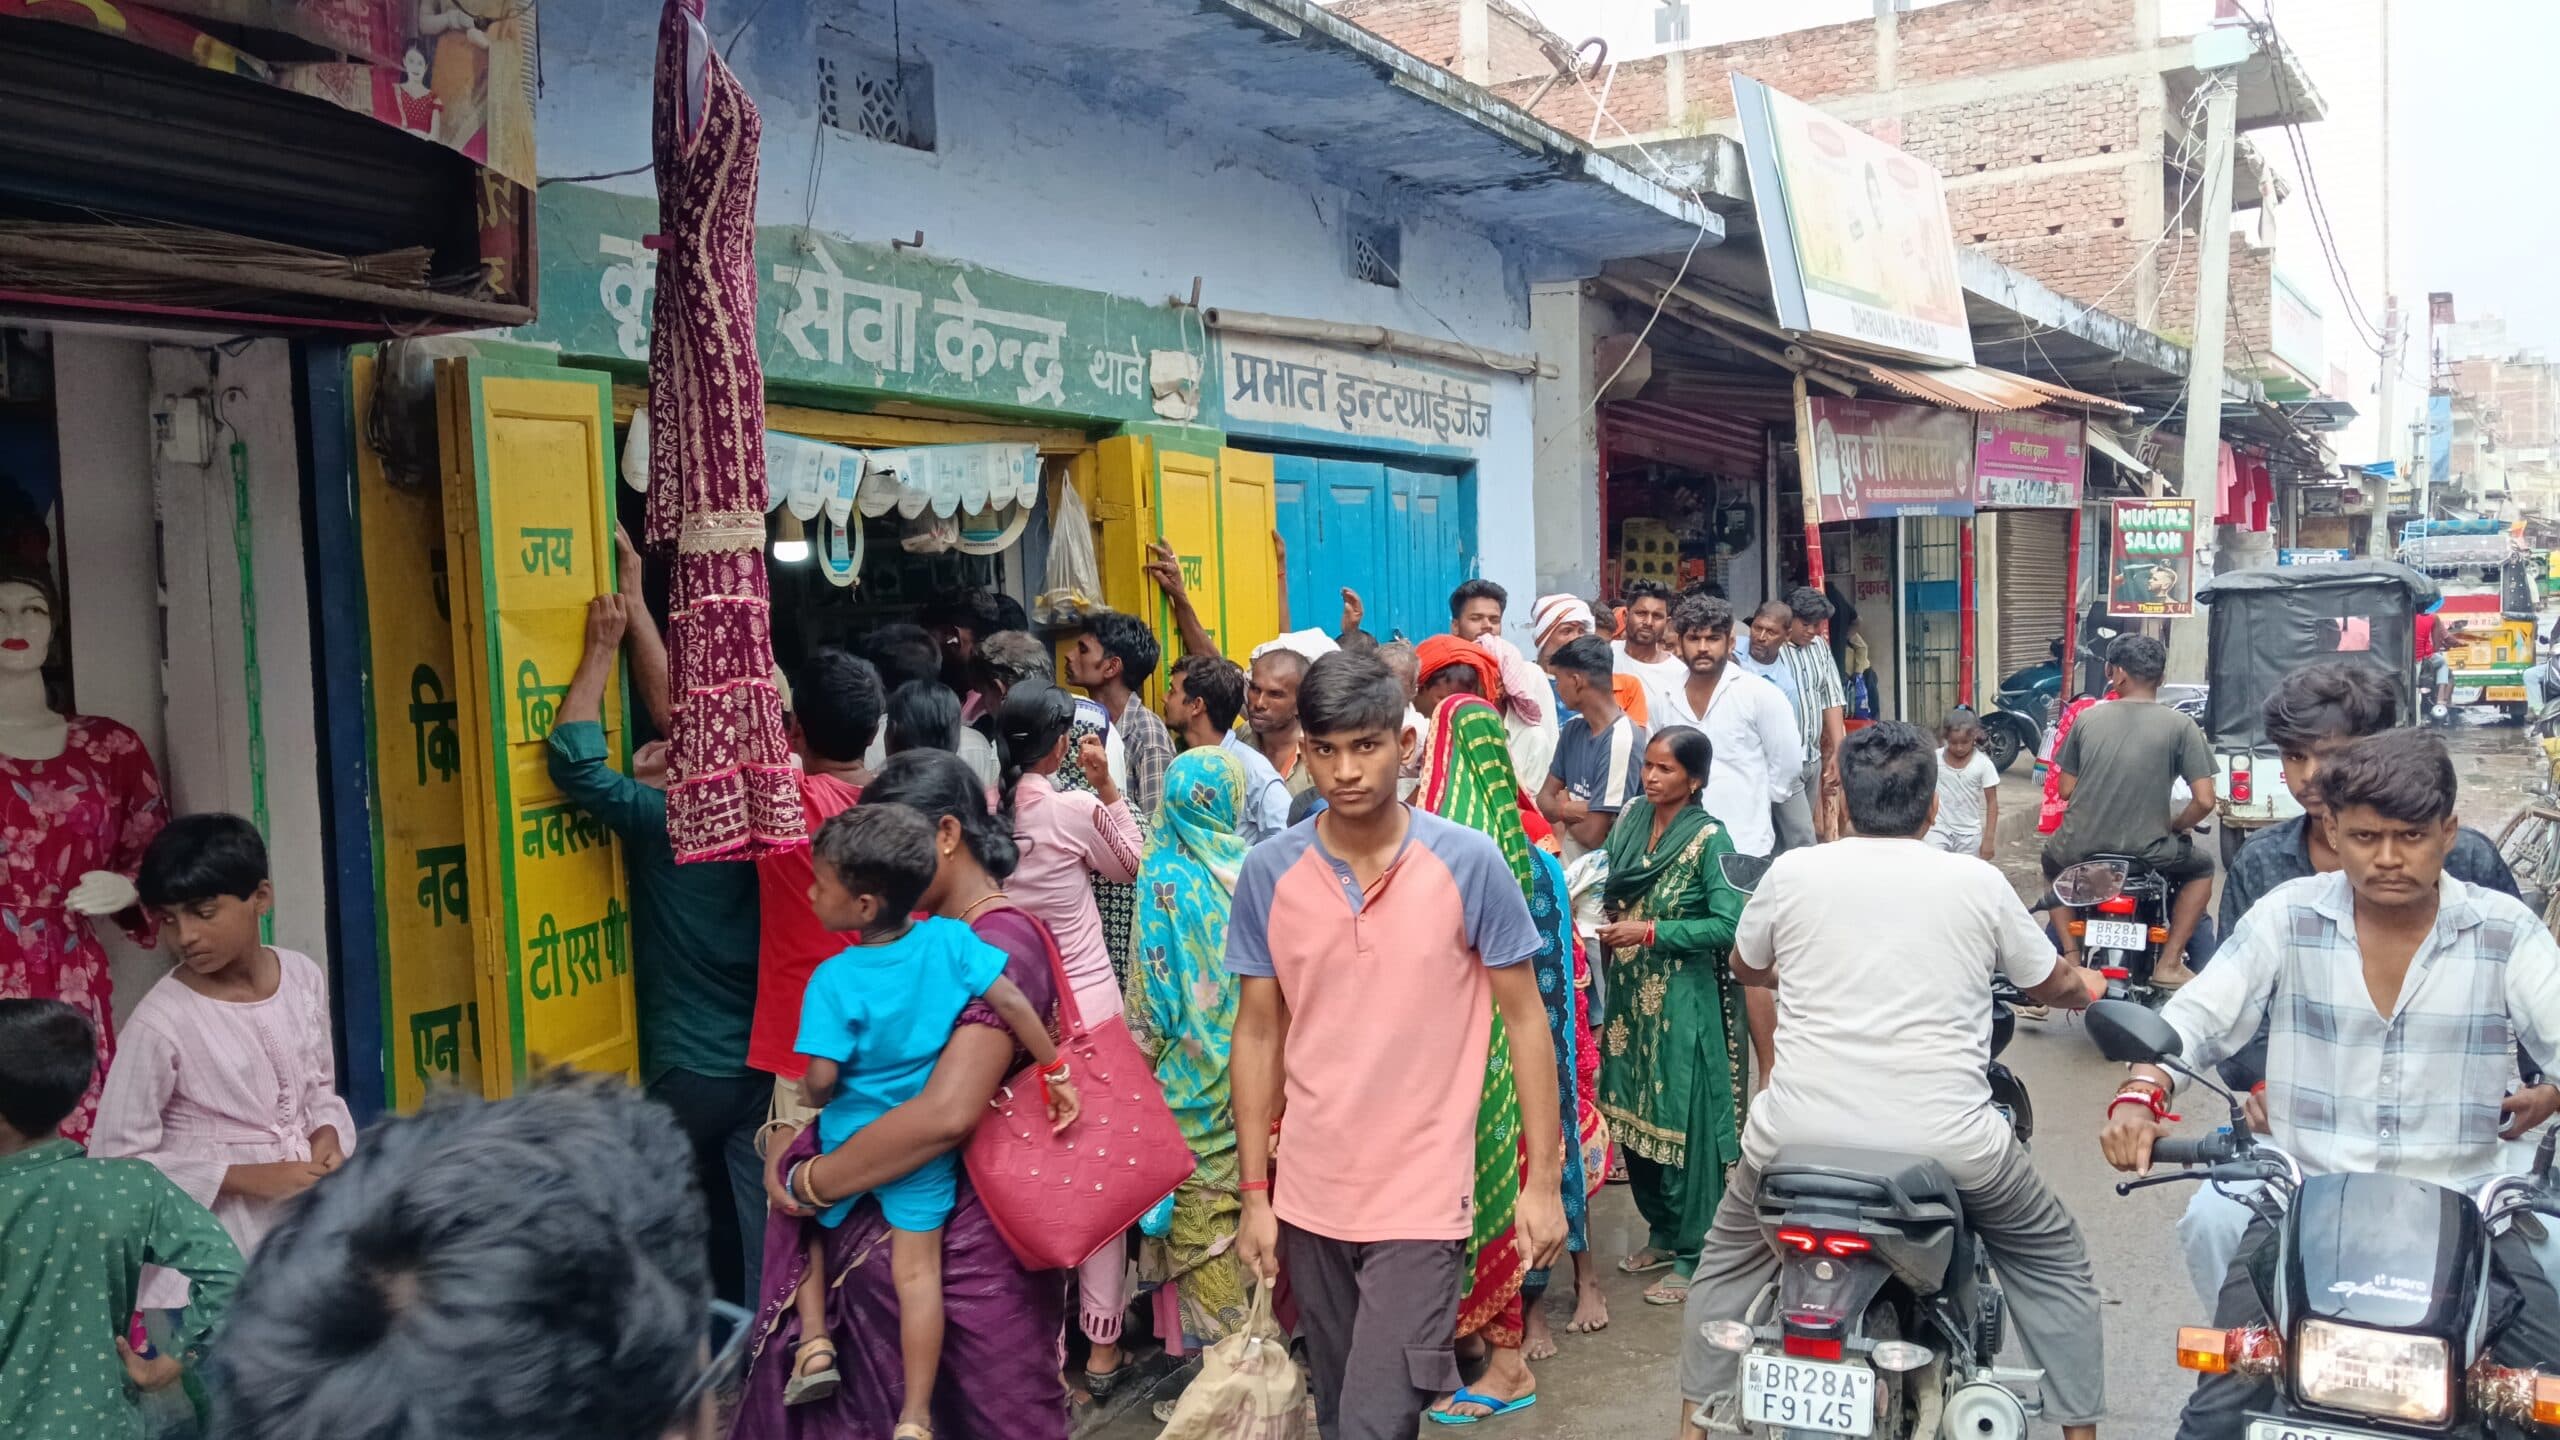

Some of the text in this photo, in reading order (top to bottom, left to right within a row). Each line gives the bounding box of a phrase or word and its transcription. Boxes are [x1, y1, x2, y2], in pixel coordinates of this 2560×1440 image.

[773, 239, 923, 374] सेवा
[933, 271, 1067, 407] केन्द्र
[1087, 335, 1147, 400] थावे
[1231, 352, 1328, 412] प्रभात
[2118, 508, 2192, 531] MUMTAZ
[520, 527, 573, 577] जय
[2124, 531, 2184, 554] SALON
[2096, 922, 2138, 936] BR28A
[528, 896, 628, 1001] टी एस पी
[1766, 1363, 1856, 1400] BR28A
[1763, 1393, 1854, 1430] F9145
